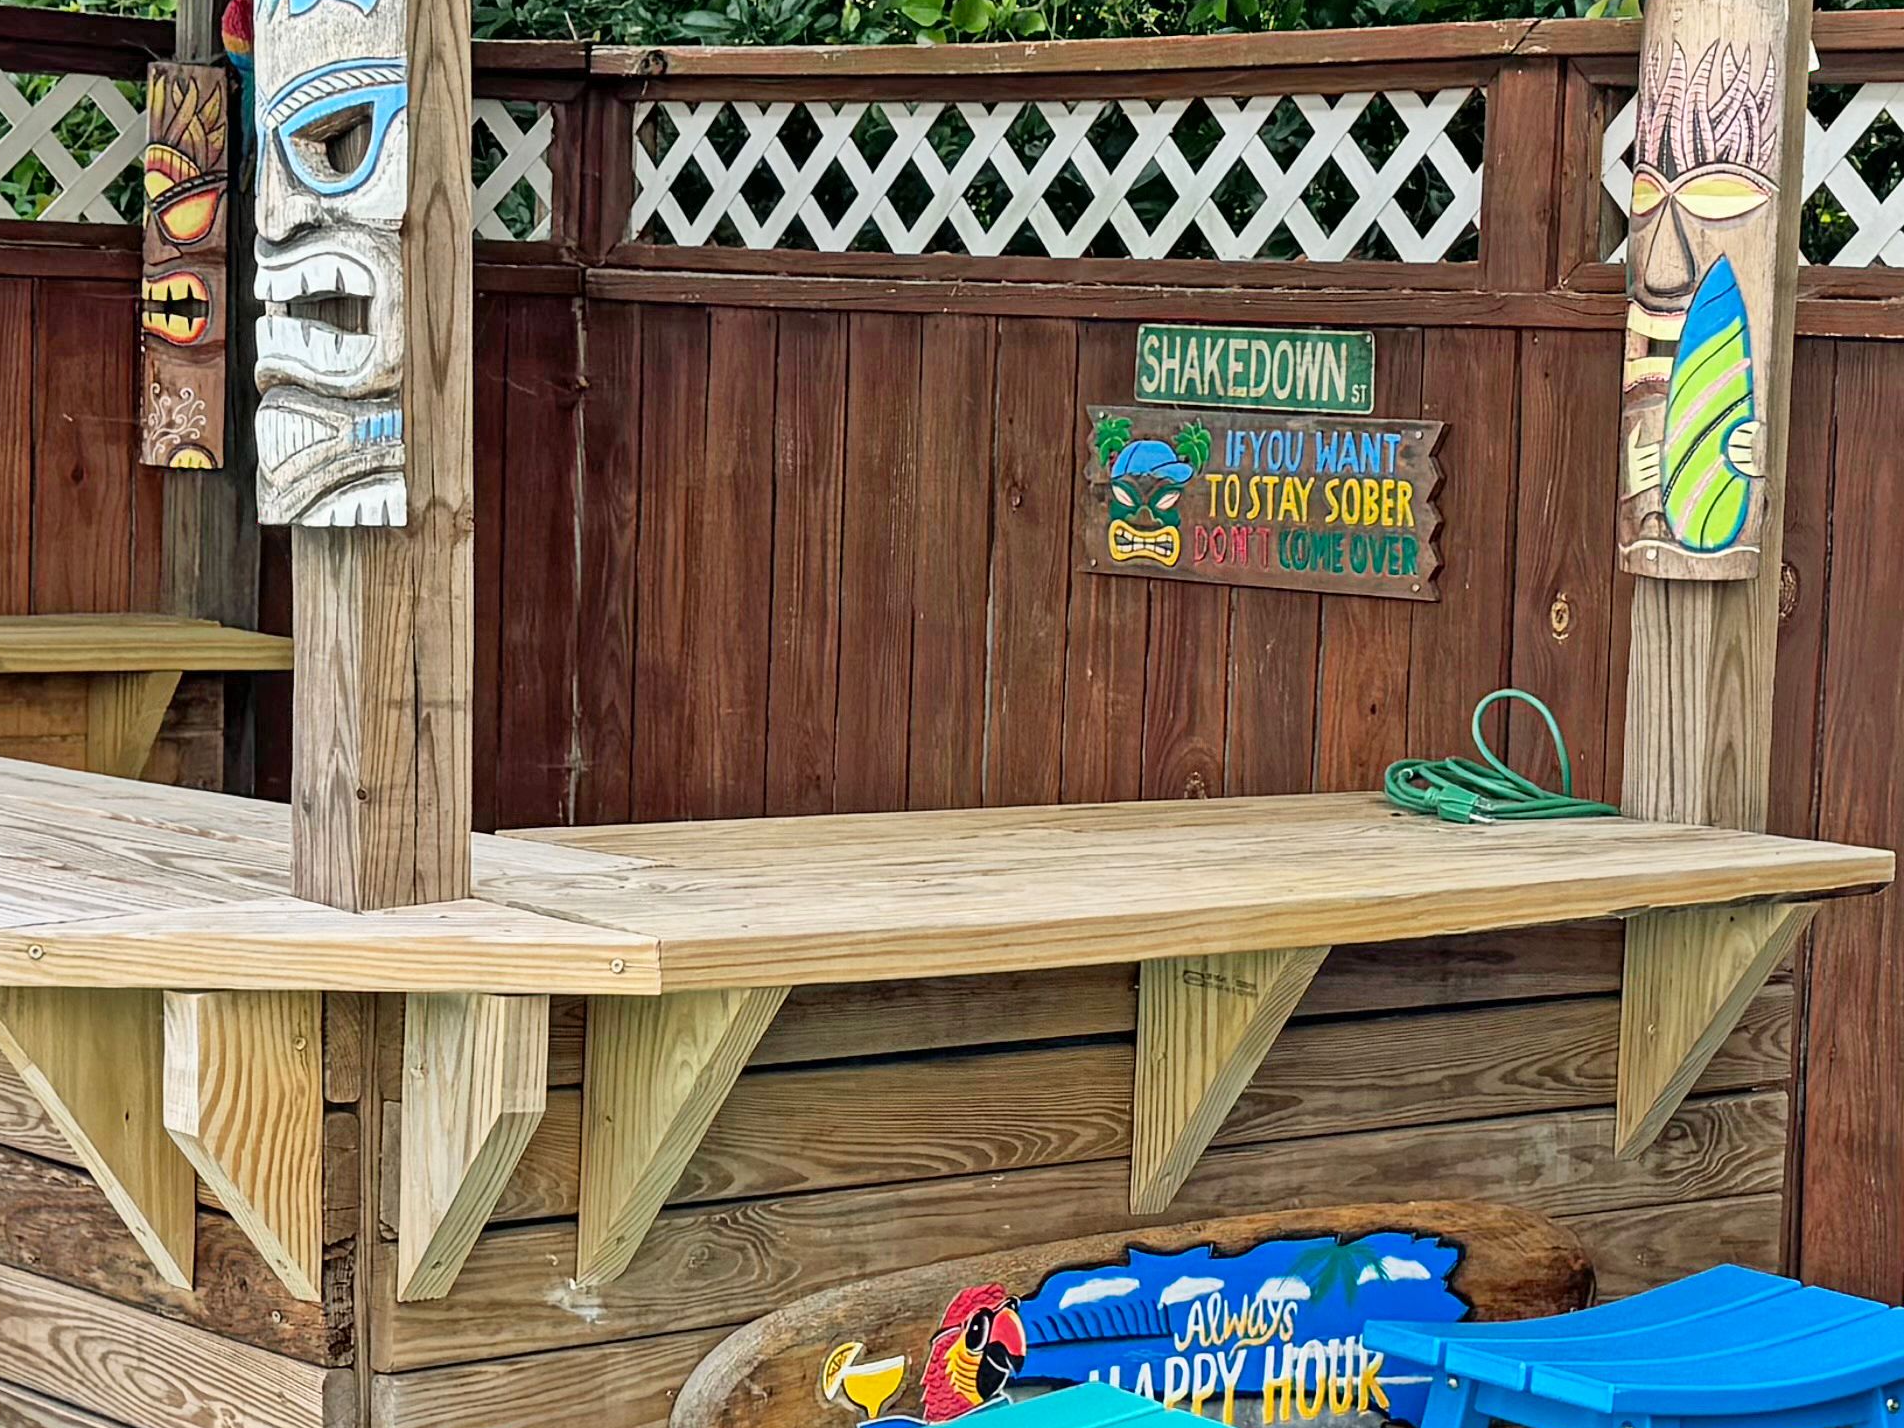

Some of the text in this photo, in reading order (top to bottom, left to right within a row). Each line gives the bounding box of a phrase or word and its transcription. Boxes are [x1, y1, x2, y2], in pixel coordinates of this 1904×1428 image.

[1140, 334, 1367, 404] SHAKEDOWN ST
[1224, 429, 1402, 474] IF YOU WANT
[1204, 473, 1416, 528] TO STAY SOBER
[1193, 523, 1420, 577] DON'T COME OVER
[1088, 1333, 1391, 1425] PPY HOUR
